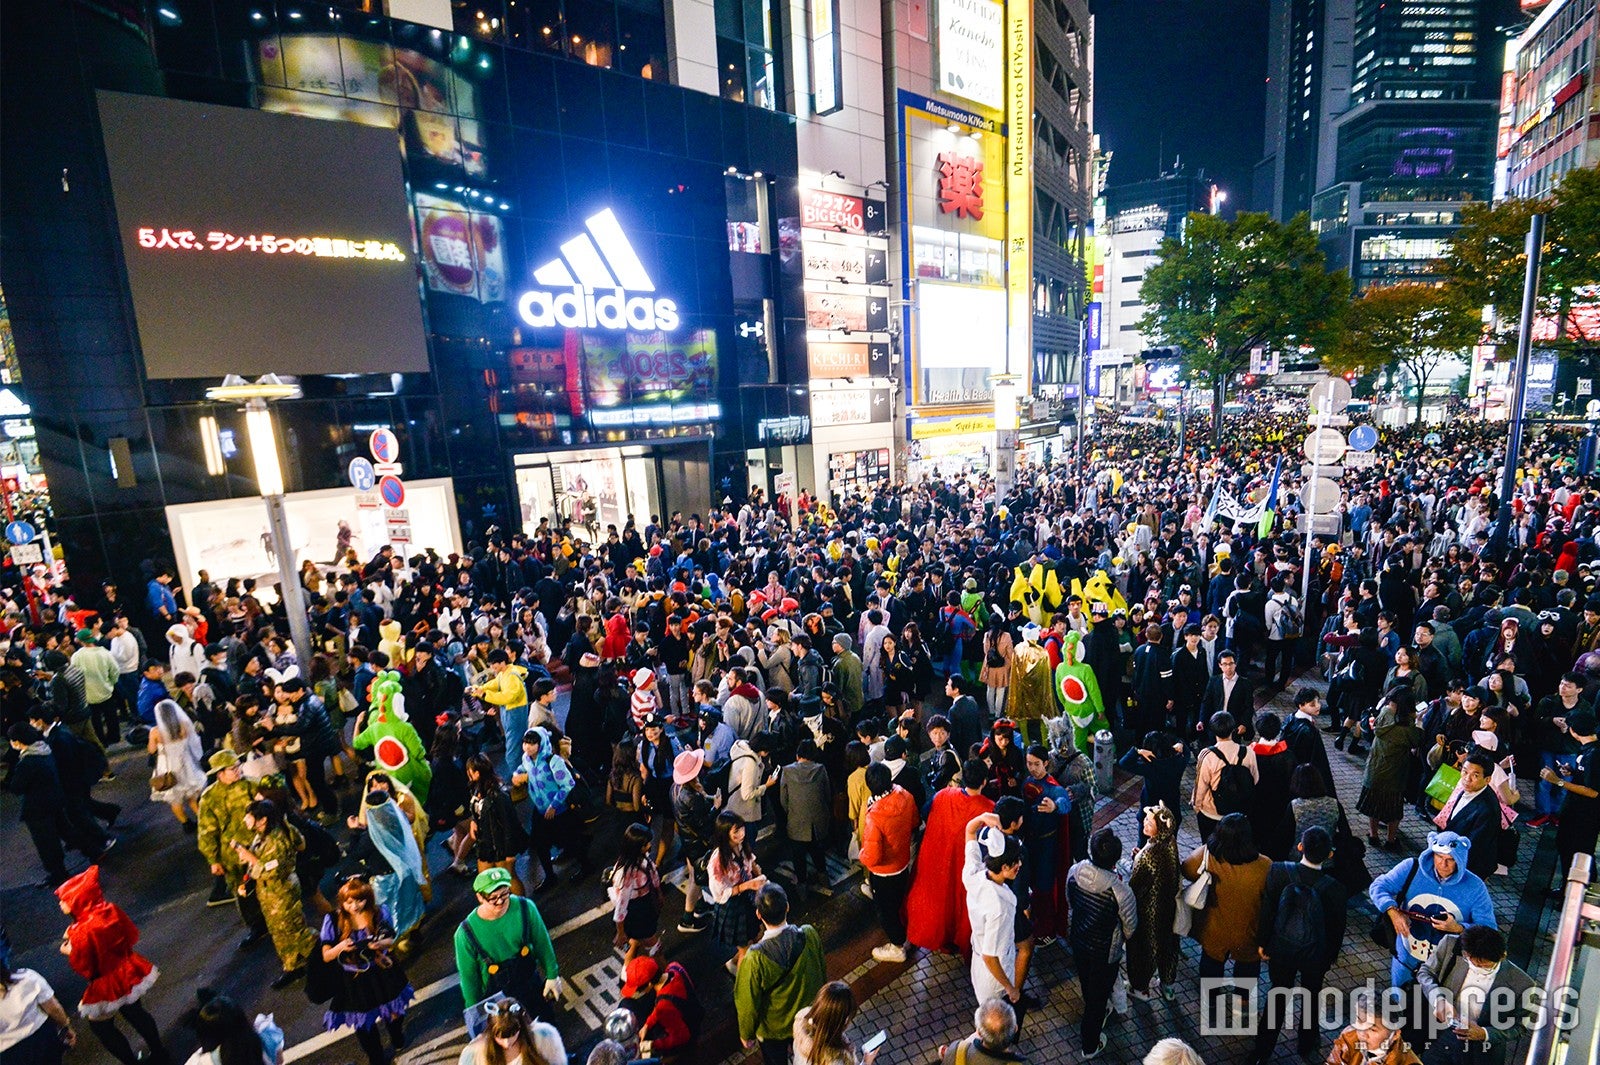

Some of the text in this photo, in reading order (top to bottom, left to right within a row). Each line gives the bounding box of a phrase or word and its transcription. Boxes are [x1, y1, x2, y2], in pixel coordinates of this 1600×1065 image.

[926, 100, 968, 123] Matsumoto
[1014, 83, 1025, 177] Matsumoto
[938, 150, 984, 221] 薬
[519, 283, 680, 331] adidas
